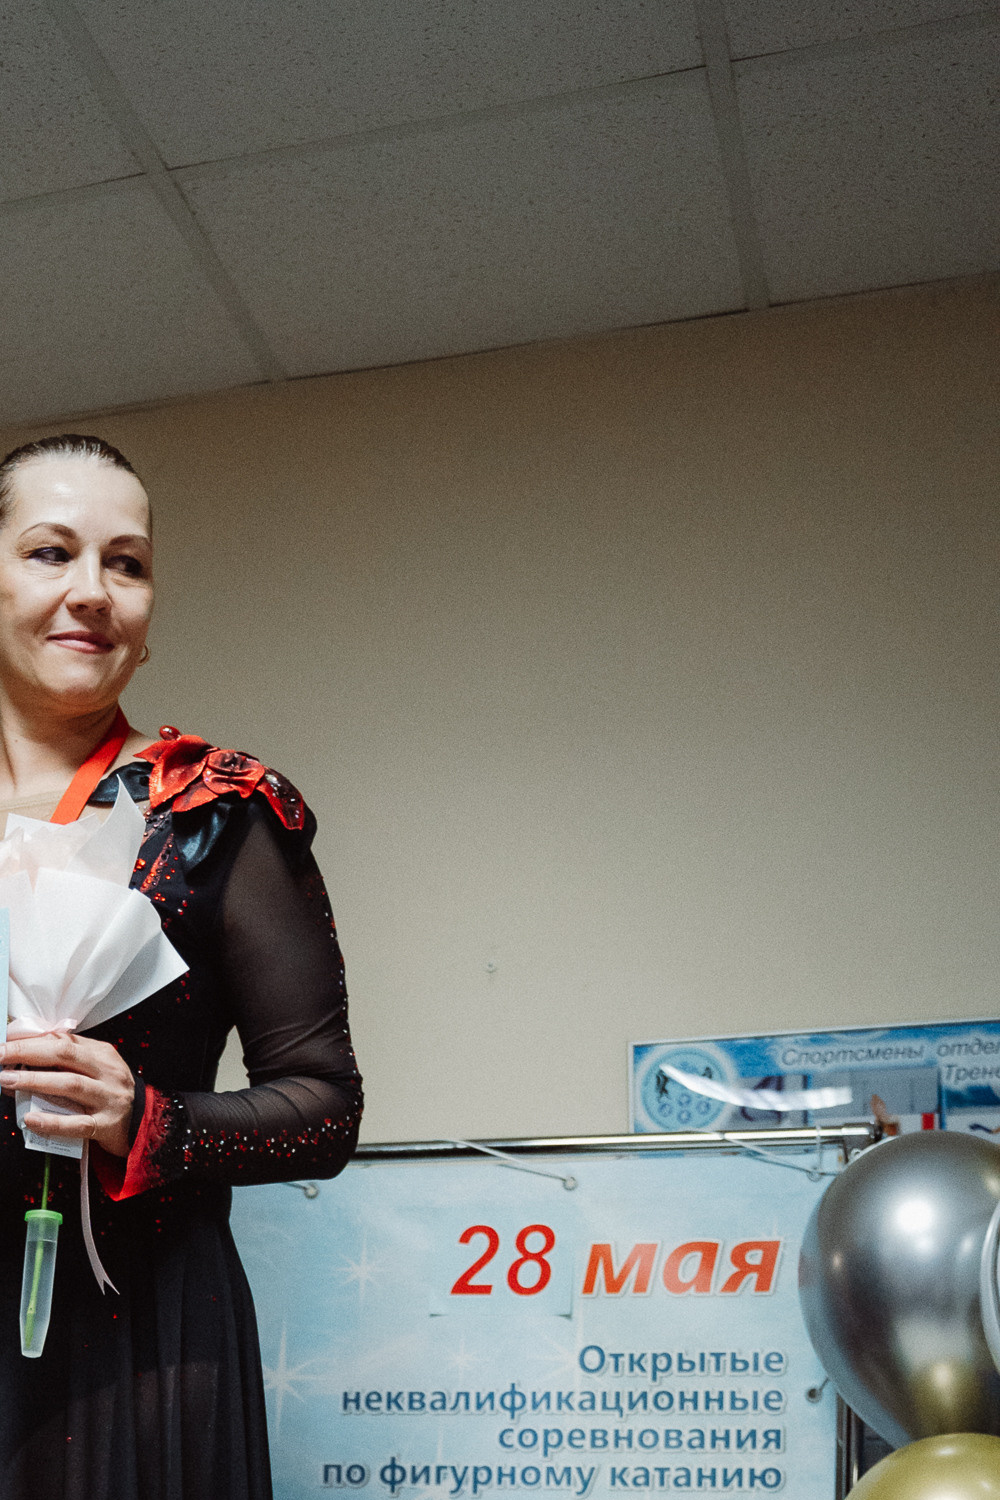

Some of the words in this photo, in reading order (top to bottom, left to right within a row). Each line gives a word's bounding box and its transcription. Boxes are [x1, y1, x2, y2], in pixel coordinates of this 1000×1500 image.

[781, 1046, 925, 1066] Спортсмены
[450, 1224, 556, 1296] 28
[581, 1238, 781, 1296] мая
[579, 1345, 784, 1380] Открытые
[341, 1383, 784, 1420] неквалификационные
[499, 1425, 782, 1457] соревнования
[323, 1461, 367, 1487] по
[379, 1457, 595, 1494] фигурному
[609, 1463, 782, 1490] катанию
